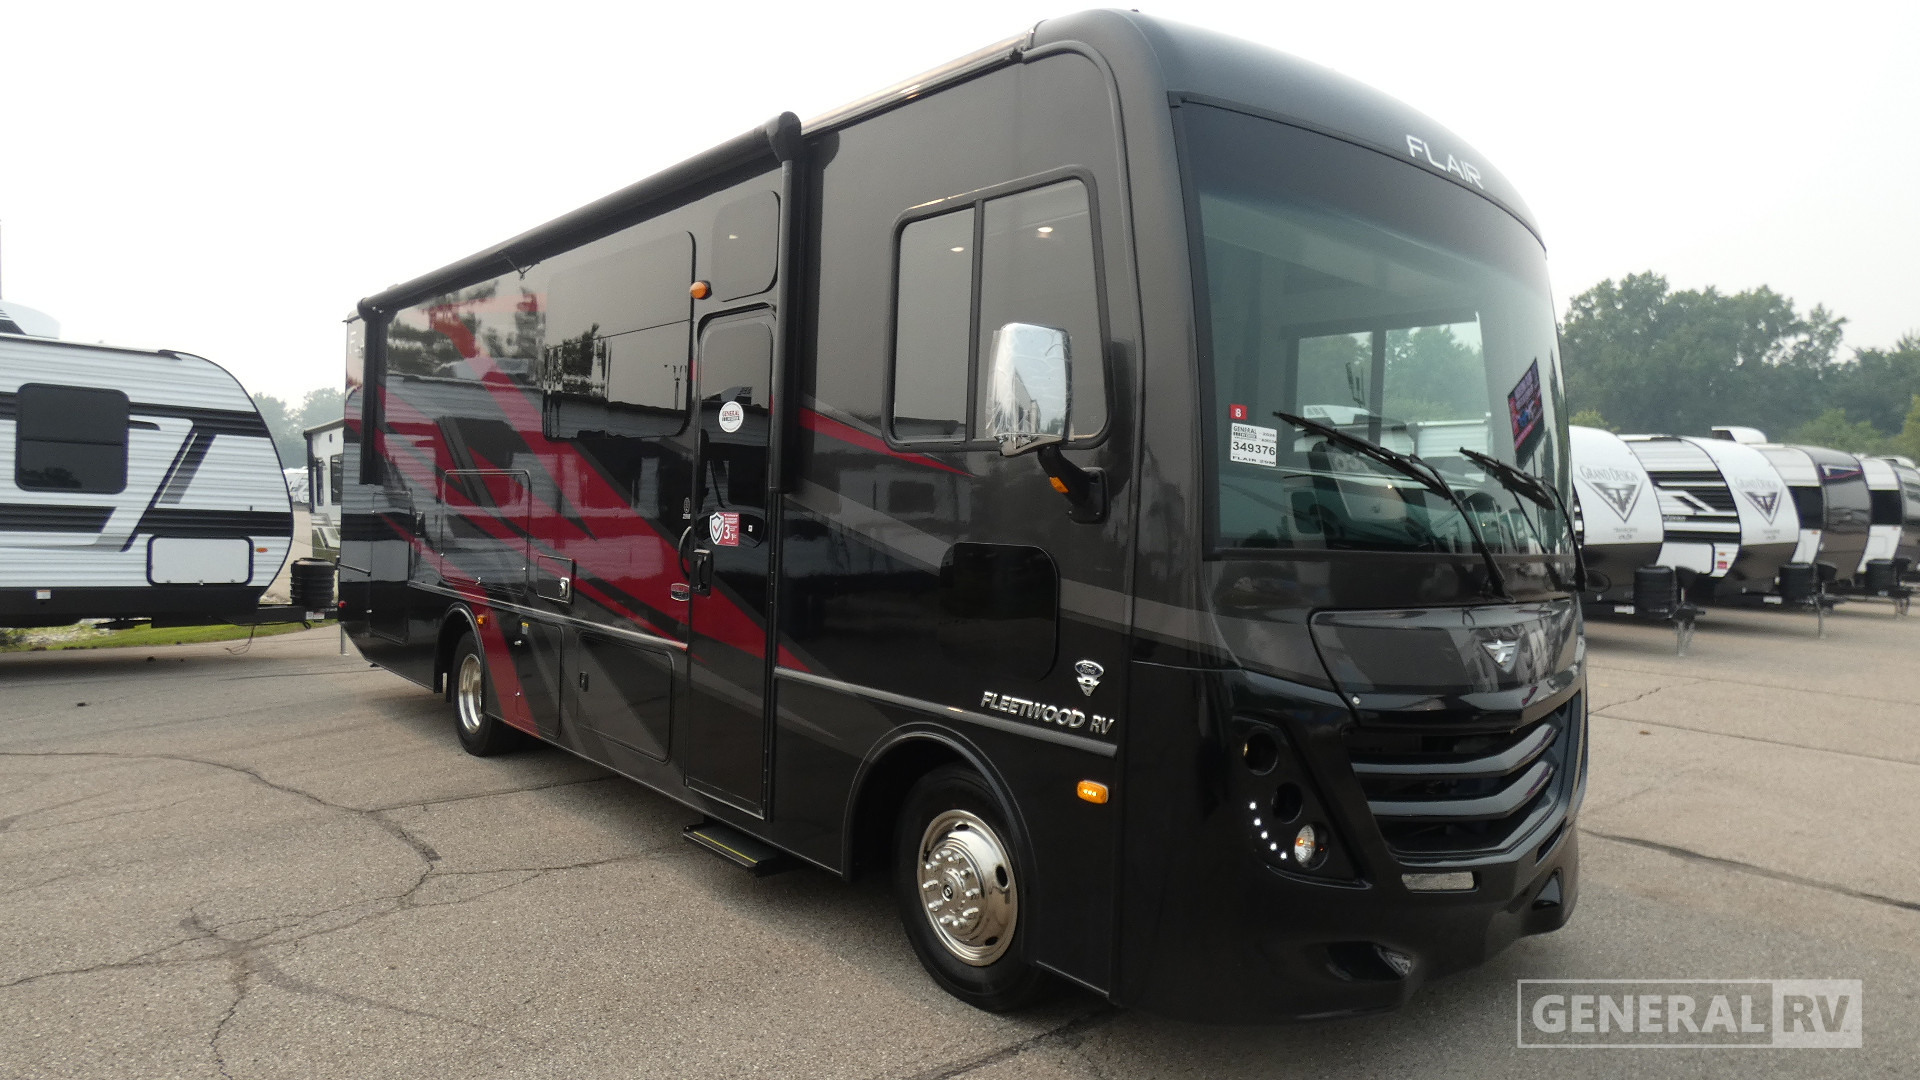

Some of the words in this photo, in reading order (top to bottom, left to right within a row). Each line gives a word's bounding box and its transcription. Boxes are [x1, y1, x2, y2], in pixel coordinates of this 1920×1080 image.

[1406, 134, 1484, 190] FLAIR
[1235, 408, 1242, 418] 8
[1233, 441, 1275, 456] 349376
[724, 524, 730, 540] 3
[980, 691, 1085, 728] FLEETWOOD
[1089, 715, 1115, 735] RV
